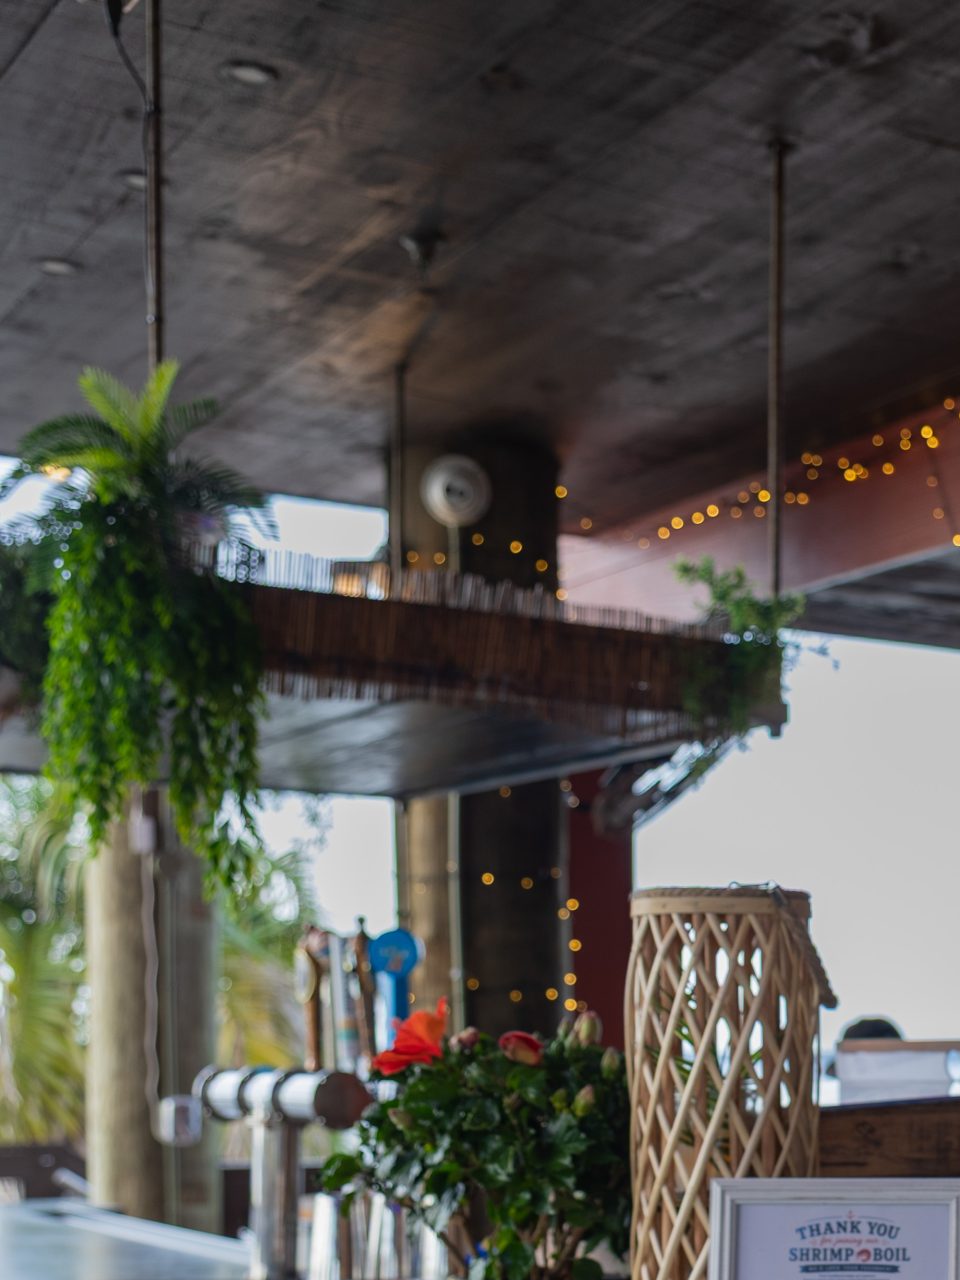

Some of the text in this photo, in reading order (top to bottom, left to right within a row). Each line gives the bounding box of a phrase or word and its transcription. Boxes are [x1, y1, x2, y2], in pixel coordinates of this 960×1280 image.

[795, 1220, 900, 1240] THANK YOU
[788, 1248, 911, 1262] SHRIMP BOIL
